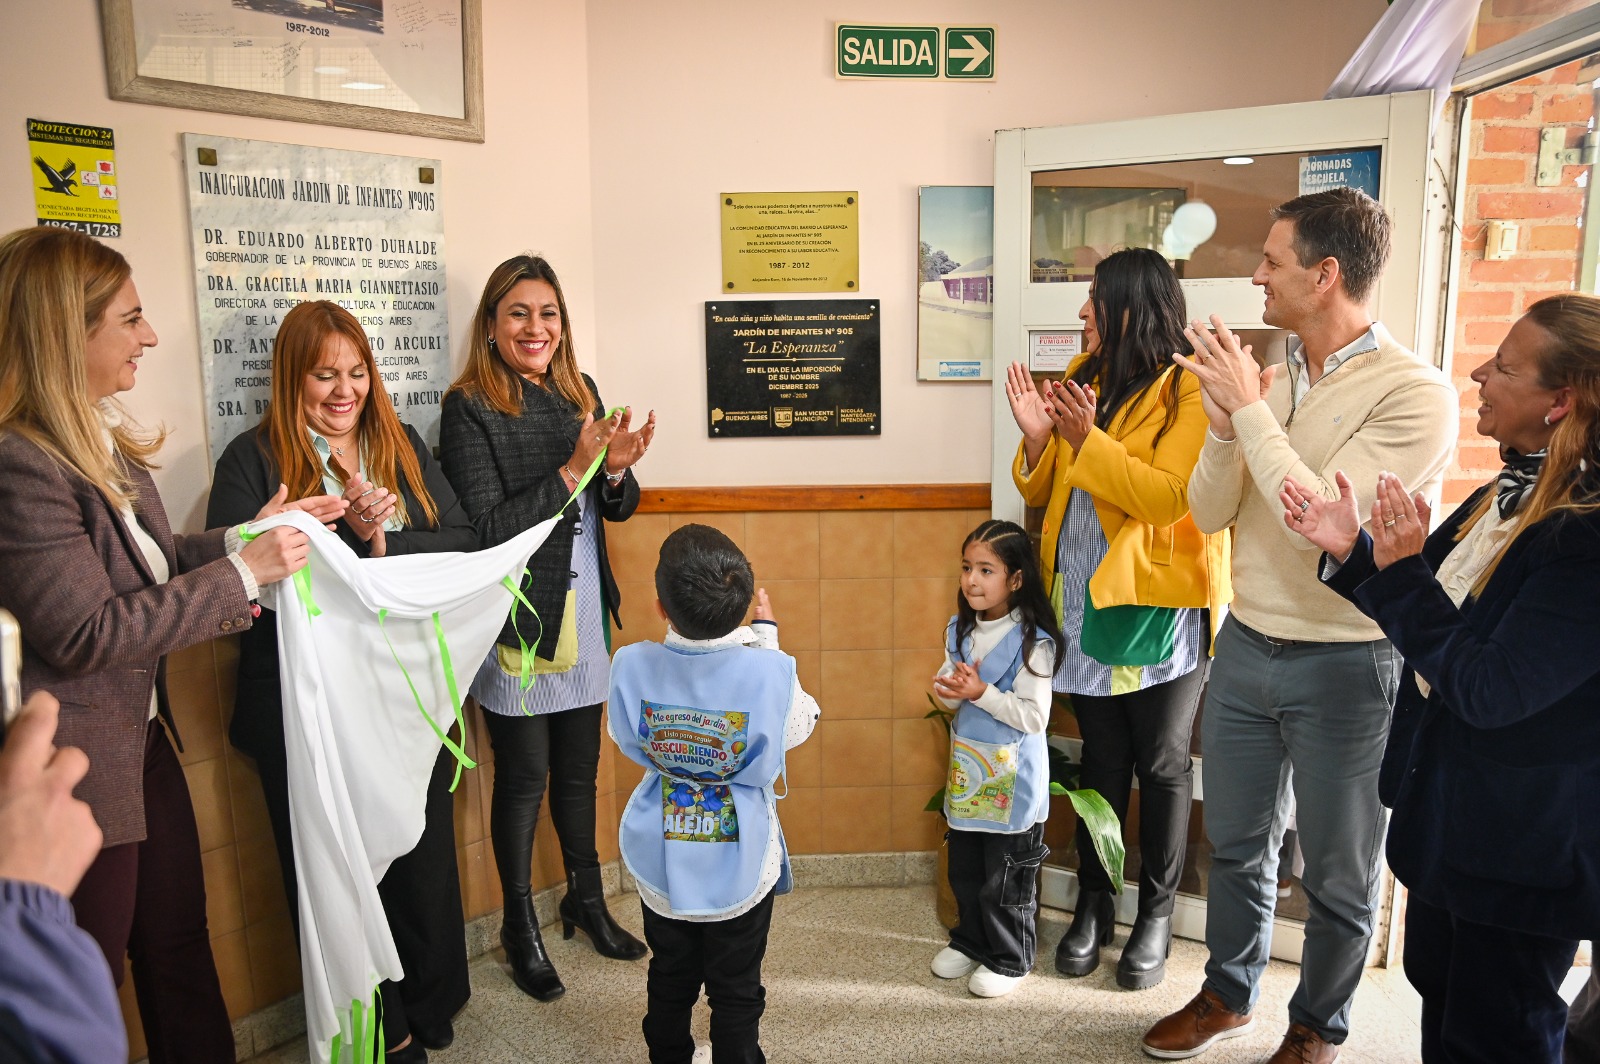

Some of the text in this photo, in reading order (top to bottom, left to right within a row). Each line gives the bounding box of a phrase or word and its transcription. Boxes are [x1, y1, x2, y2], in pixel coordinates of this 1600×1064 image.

[285, 21, 330, 37] 1987-2012
[843, 37, 933, 66] SALIDA
[30, 122, 112, 140] PROTECCION 24
[30, 132, 113, 147] SISTEMAS DE SEGURIDAD
[1306, 158, 1352, 172] JORNADAS
[1306, 172, 1348, 185] ESCUELA,
[199, 171, 285, 200] INAUGURACION
[292, 180, 331, 203] JARDIN
[337, 184, 350, 205] DE
[356, 185, 403, 209] INFANTES
[204, 229, 437, 256] DR. EDUARDO ALBERTO DUHALDE
[205, 251, 437, 271] GOBERNADOR DE LA PROVINCIA DE BUENOS AIRES
[207, 275, 439, 296] DRA. GRACIELA MARIA GIANNETTASIO
[214, 298, 267, 309] DIRECTORA
[338, 300, 435, 311] CULTURA Y EDUCACION
[245, 315, 278, 326] DE LA
[389, 316, 412, 326] AIRES
[754, 316, 759, 324] y
[759, 314, 773, 322] niño
[773, 314, 793, 322] habita
[733, 327, 766, 337] JARDÍN
[781, 328, 823, 336] INFANTES
[213, 338, 238, 354] DR.
[394, 336, 441, 351] ARCURI
[375, 356, 420, 366] EJECUTORA
[406, 371, 428, 381] AIRES
[801, 365, 842, 373] IMPOSICIÓN
[217, 401, 247, 417] SRA.
[652, 713, 665, 723] Me
[665, 713, 691, 723] egreso
[691, 712, 703, 724] del
[664, 730, 679, 738] Listo
[693, 735, 713, 744] seguir
[650, 741, 728, 762] DESCUBRIENDO
[662, 753, 715, 767] EL MUNDO
[664, 814, 715, 835] ALEJO
